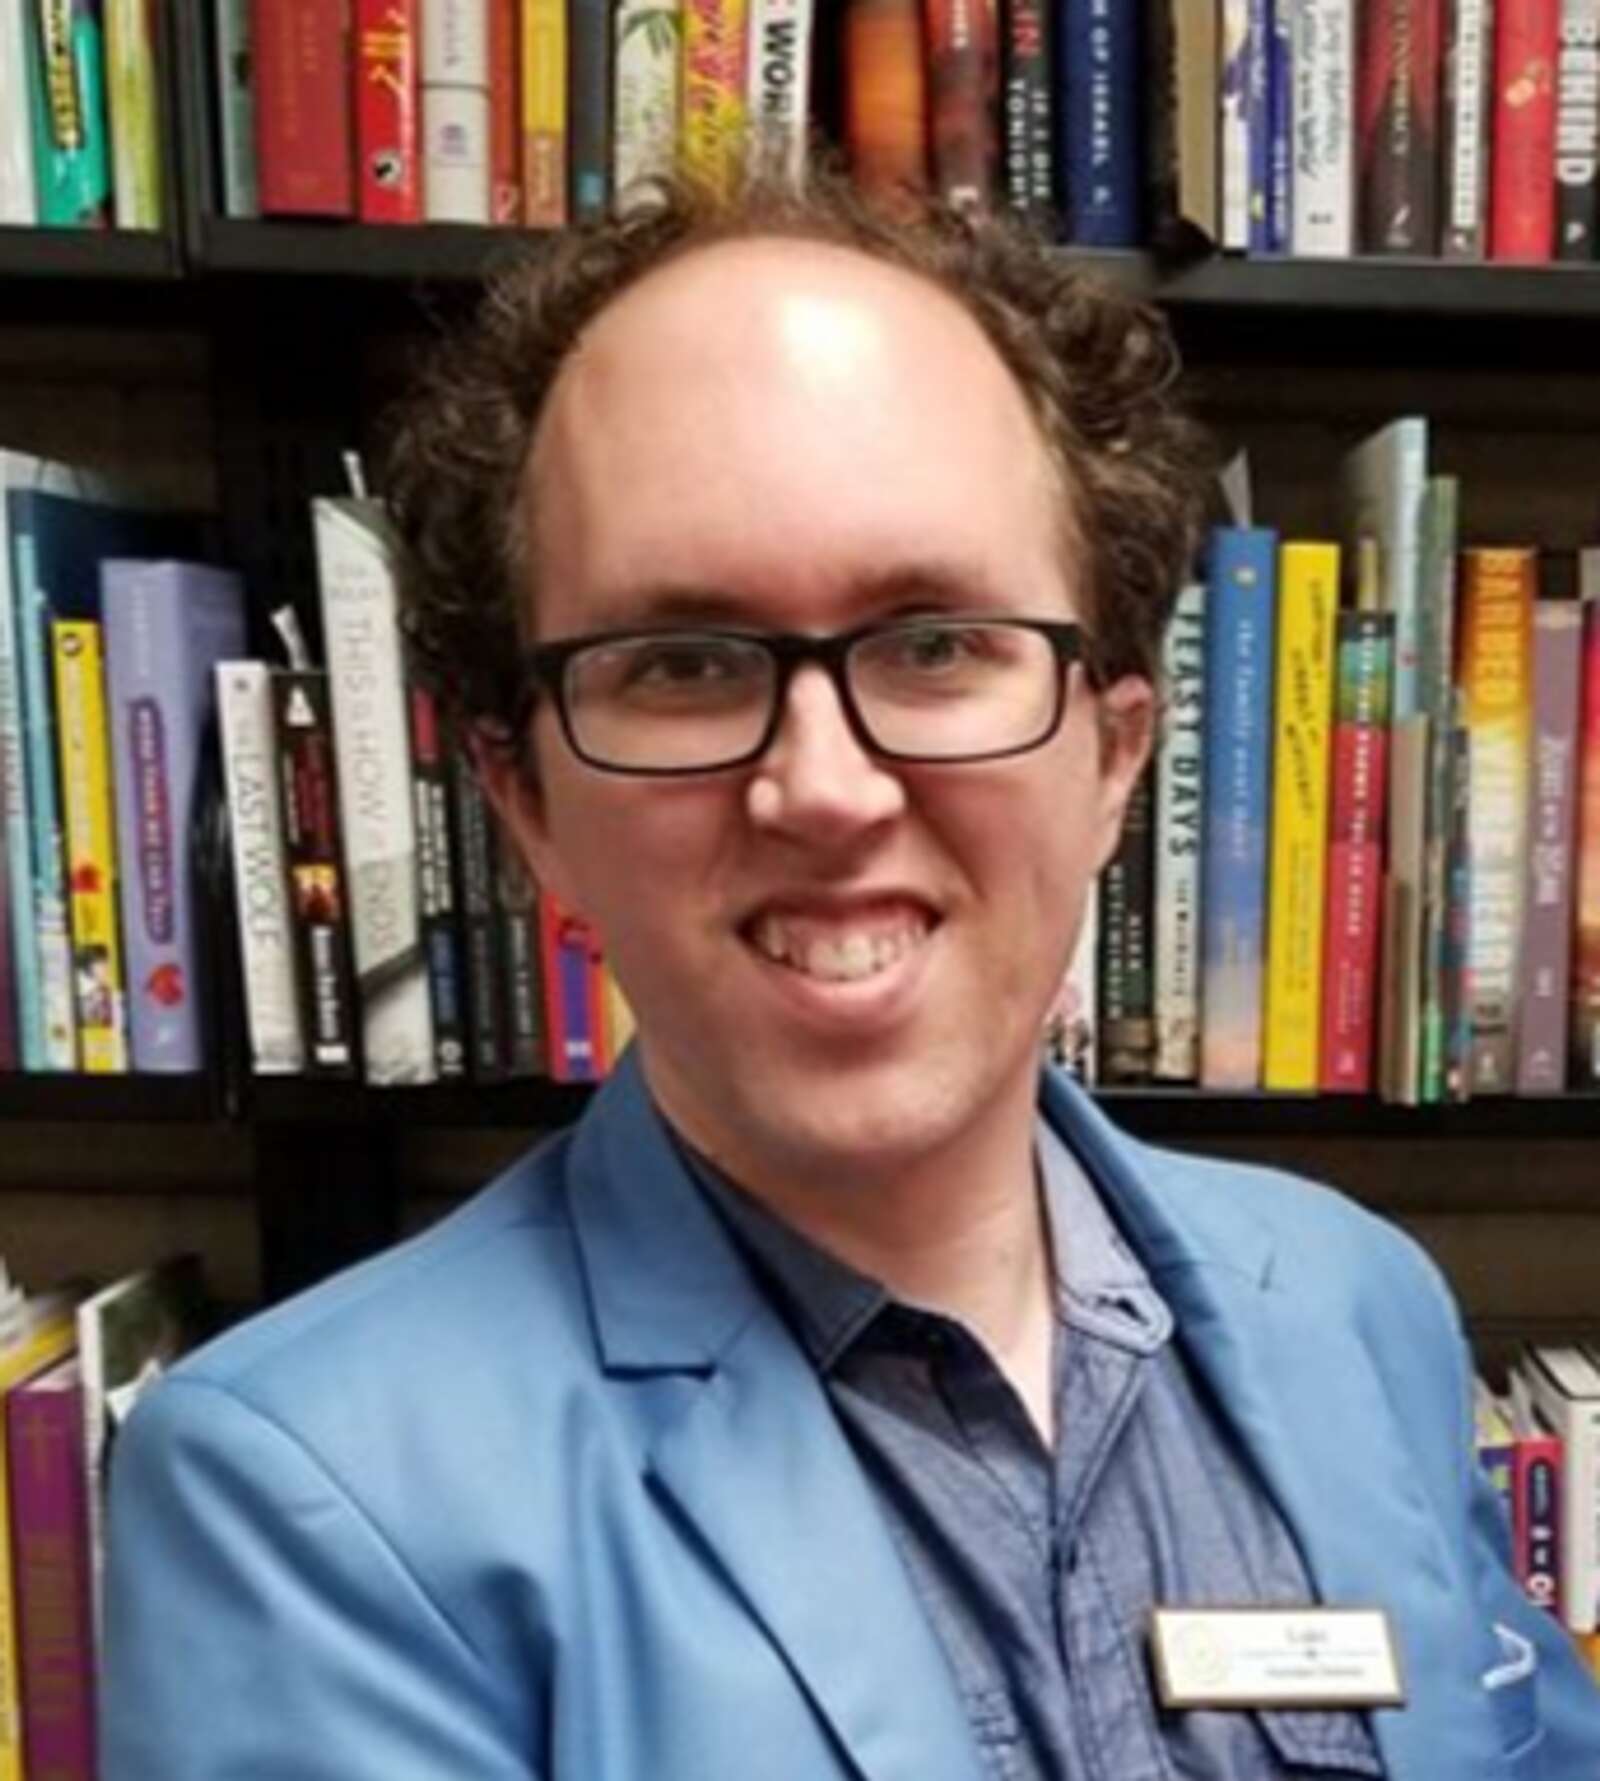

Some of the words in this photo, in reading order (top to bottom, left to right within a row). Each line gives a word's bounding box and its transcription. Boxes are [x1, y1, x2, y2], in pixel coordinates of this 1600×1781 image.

[1012, 0, 1042, 58] IN
[1008, 79, 1028, 209] TONIGHT
[1557, 18, 1598, 185] BEHIND
[232, 754, 276, 834] LAST
[351, 730, 389, 818] HOW
[1169, 756, 1200, 857] DAYS
[244, 845, 285, 949] WOLF
